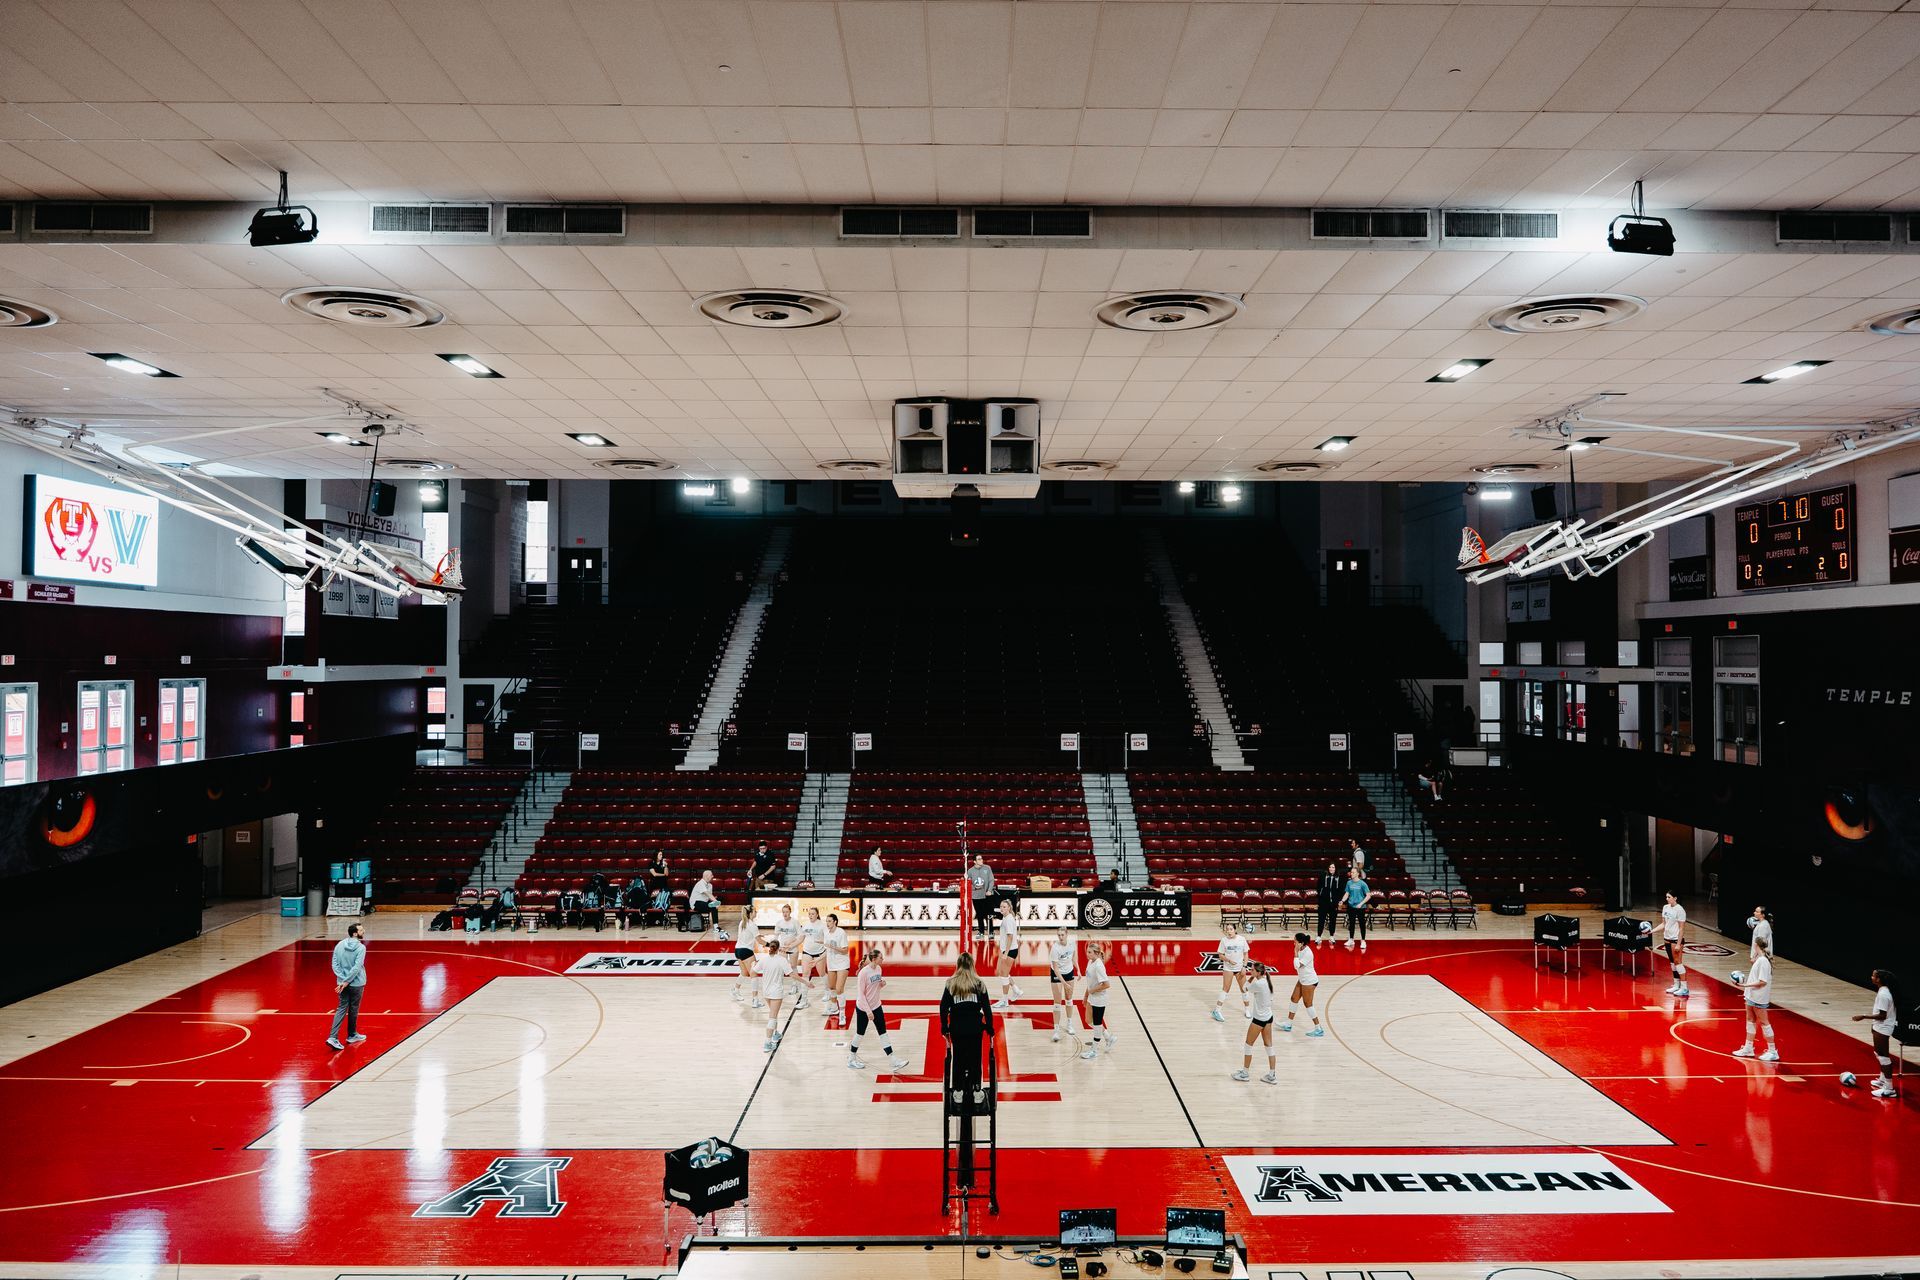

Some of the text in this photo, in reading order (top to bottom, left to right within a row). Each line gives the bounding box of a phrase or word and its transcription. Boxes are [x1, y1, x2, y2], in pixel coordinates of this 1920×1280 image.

[1821, 493, 1844, 507] GUEST
[1737, 509, 1759, 522] TEMPLE
[1778, 497, 1808, 520] 7:10
[1835, 508, 1844, 530] 0
[1750, 523, 1758, 543] 0
[1774, 532, 1791, 541] PERIOD
[1832, 541, 1846, 550] FOULS
[1766, 547, 1809, 559] PLAYER FOUL PTS
[1818, 556, 1825, 570] 2
[1840, 553, 1847, 569] 0
[1677, 570, 1706, 584] NovaCare
[1745, 564, 1751, 579] 0
[1757, 564, 1763, 577] 2
[45, 584, 59, 592] Grace
[328, 592, 344, 601] 1998
[1826, 688, 1912, 705] TEMPLE
[1608, 931, 1629, 940] molten
[707, 1176, 740, 1196] molten
[1255, 1165, 1634, 1203] AMERICAN
